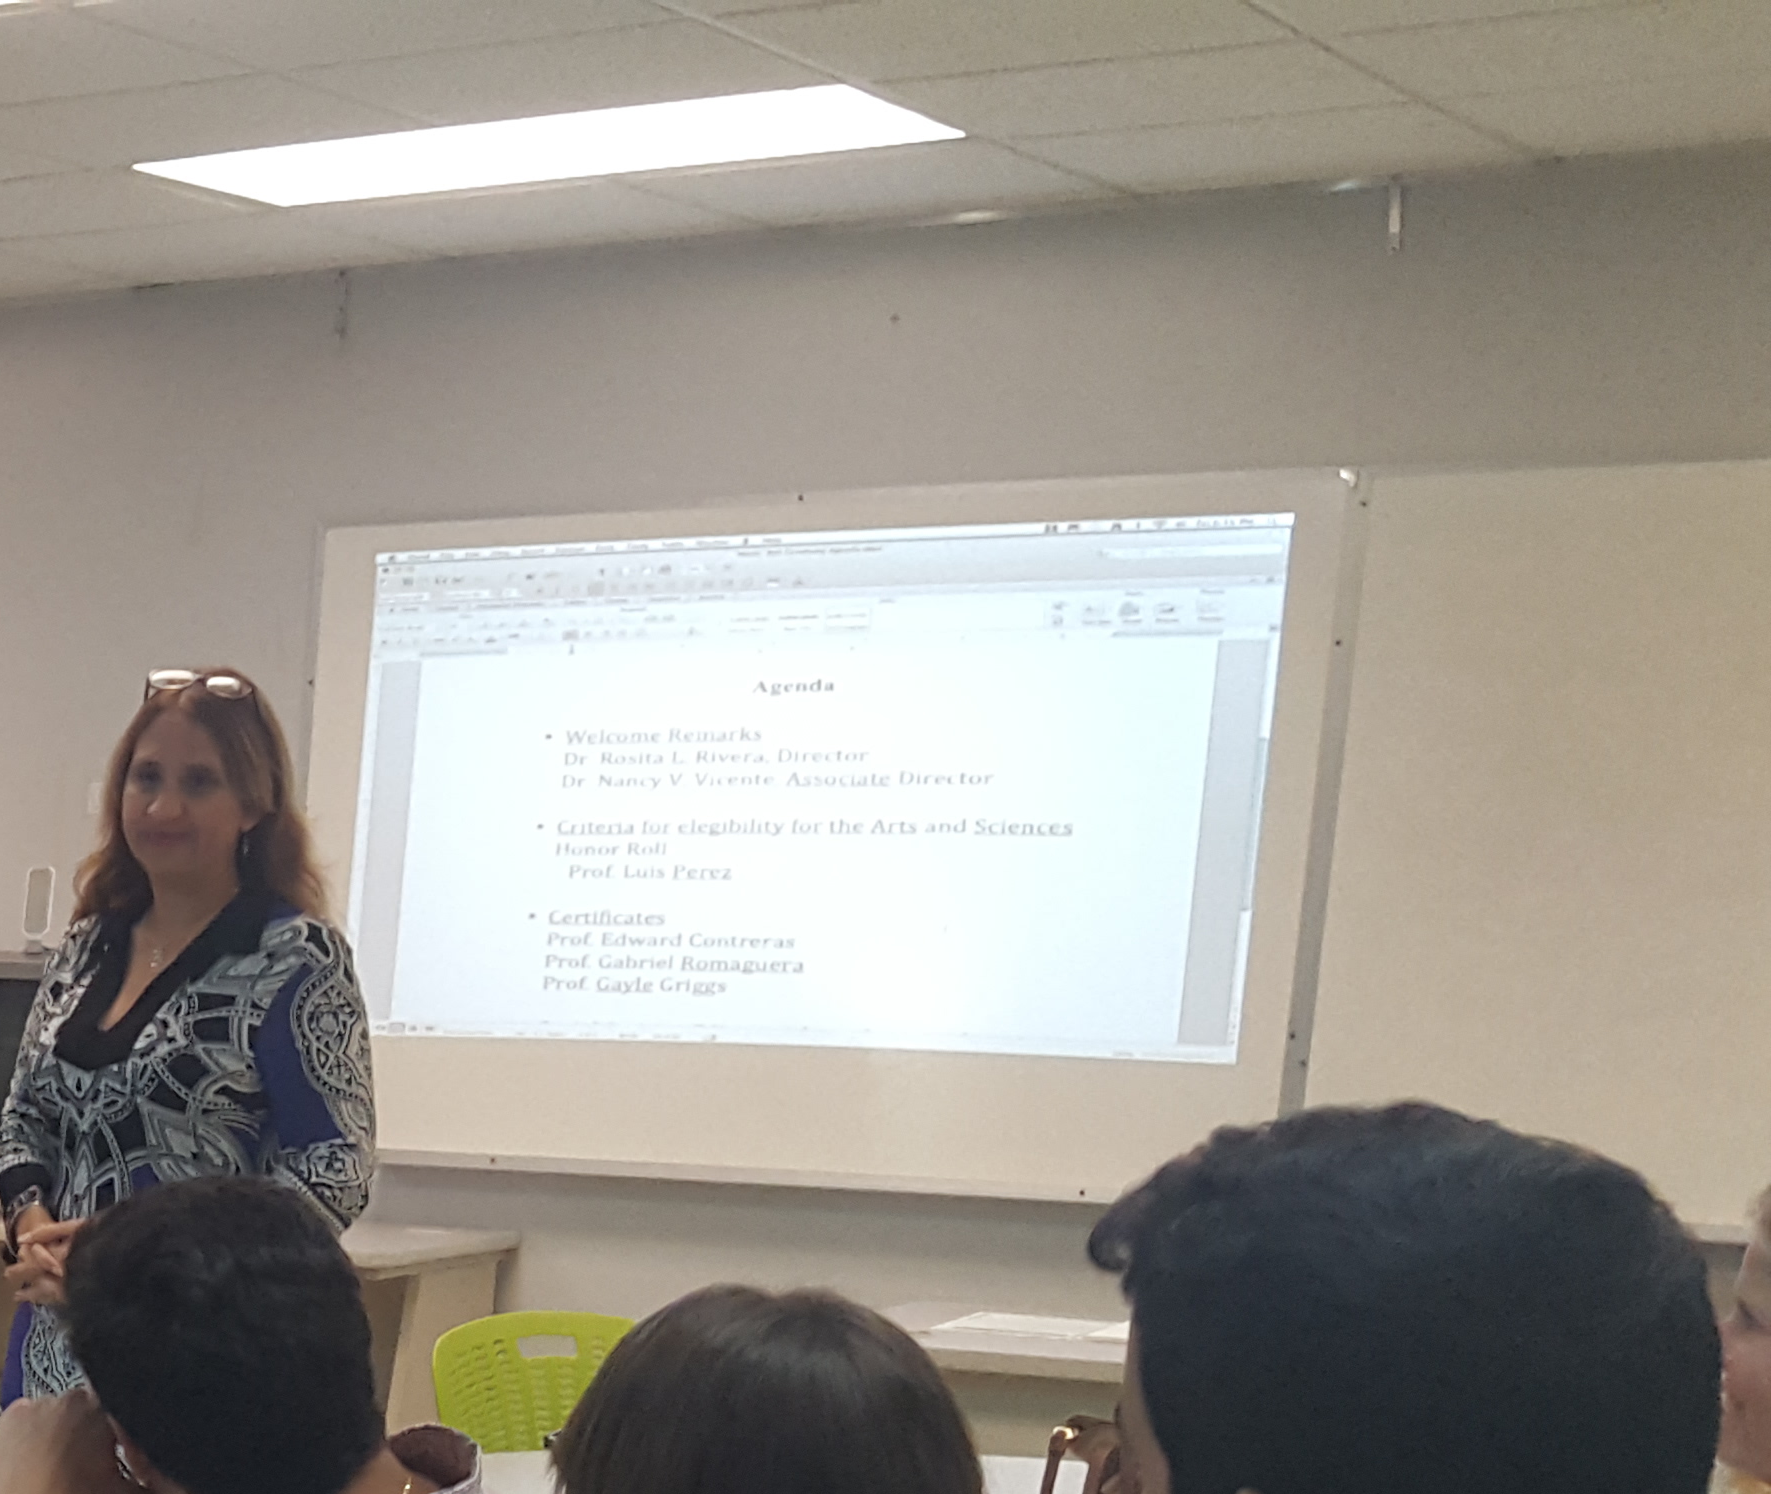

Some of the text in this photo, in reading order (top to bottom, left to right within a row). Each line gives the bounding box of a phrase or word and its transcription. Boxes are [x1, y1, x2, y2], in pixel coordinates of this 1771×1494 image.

[752, 678, 835, 696] Agenda
[566, 727, 762, 746] Welcome Remarks
[600, 750, 664, 766] Rosita
[778, 748, 869, 764] Director
[598, 773, 661, 791] Nancy
[786, 771, 891, 788] Associate
[899, 770, 994, 786] Director
[557, 818, 1073, 837] Criteria for elegibility for the Arts and Sciences
[555, 842, 667, 857] Honor Roll
[623, 864, 665, 880] Luis
[672, 864, 732, 881] Perez
[548, 909, 665, 926] Certificates
[601, 932, 682, 948] Edward
[689, 933, 795, 949] Contreras
[598, 954, 673, 970] Gabriel
[680, 956, 804, 974] Romaguera
[596, 976, 653, 995] Gayle
[659, 976, 727, 997] Griggs
